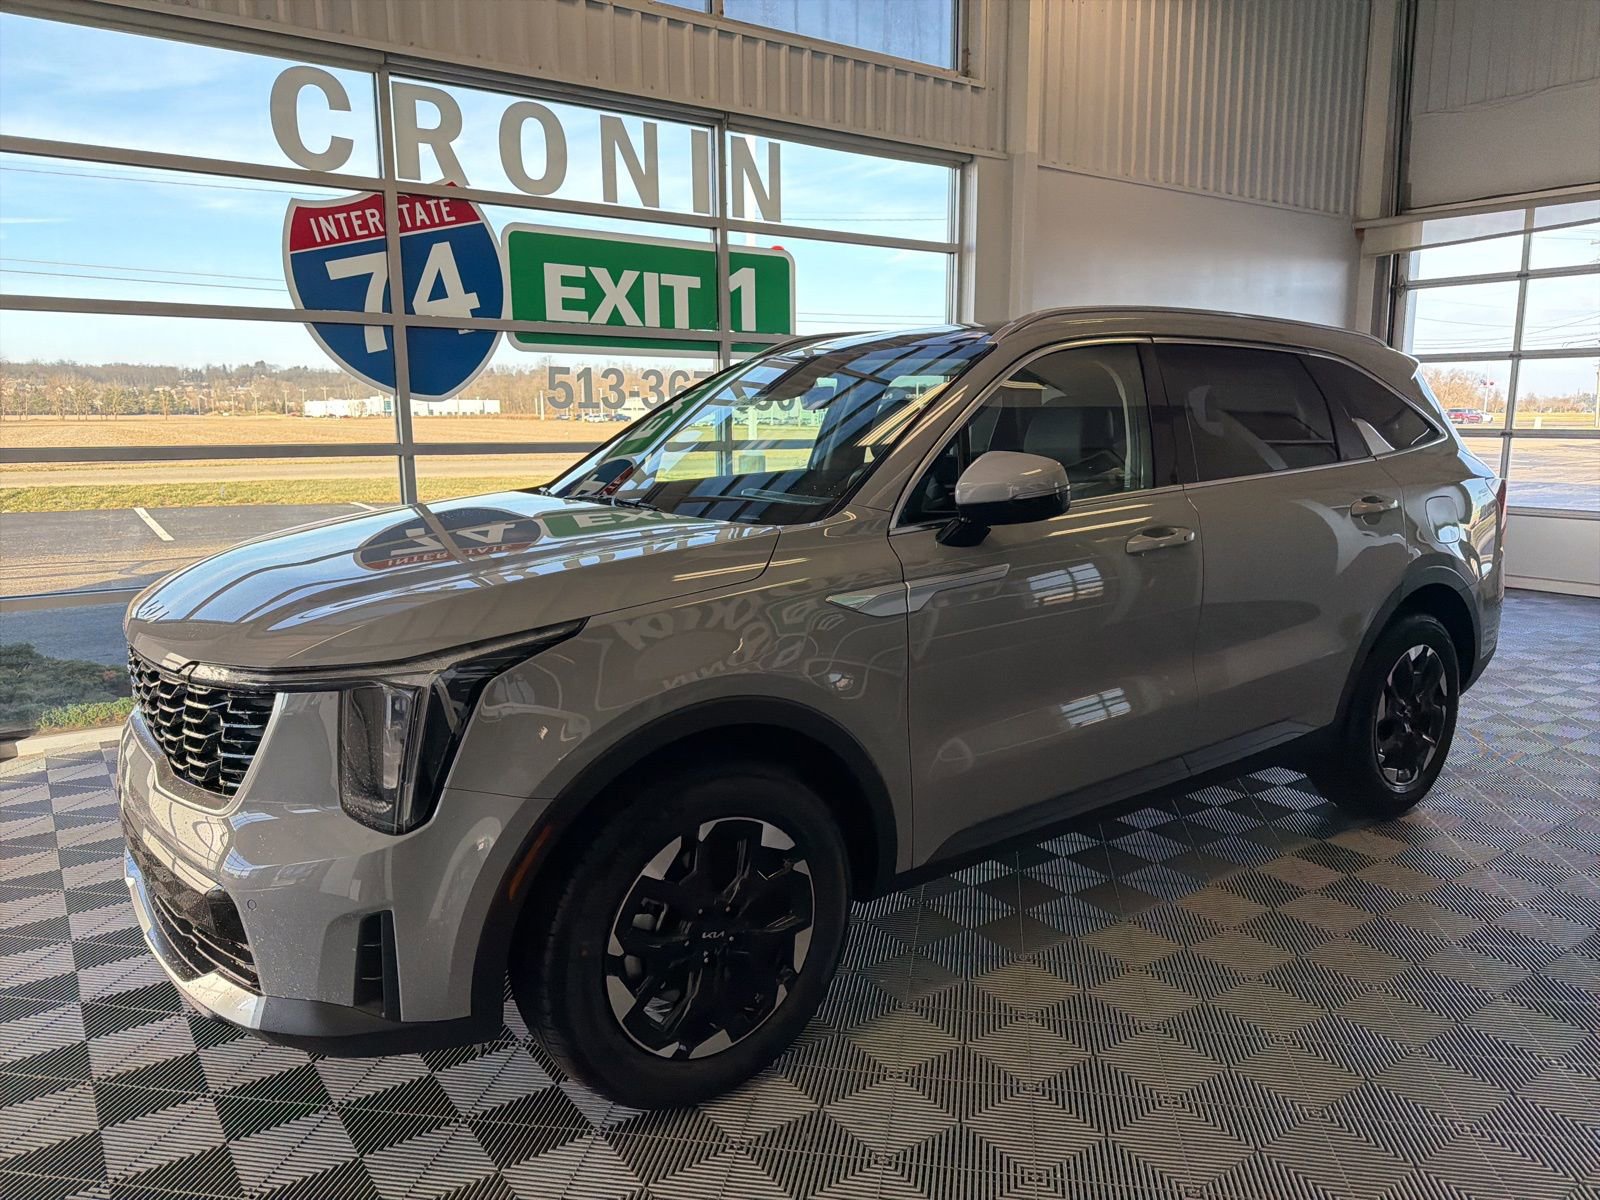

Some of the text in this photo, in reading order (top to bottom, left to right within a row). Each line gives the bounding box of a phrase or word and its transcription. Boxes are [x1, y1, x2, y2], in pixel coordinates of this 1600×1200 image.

[270, 65, 782, 223] CRONIN
[309, 199, 457, 243] INTERTATE
[325, 241, 481, 354] 74
[543, 262, 757, 332] EXIT 1
